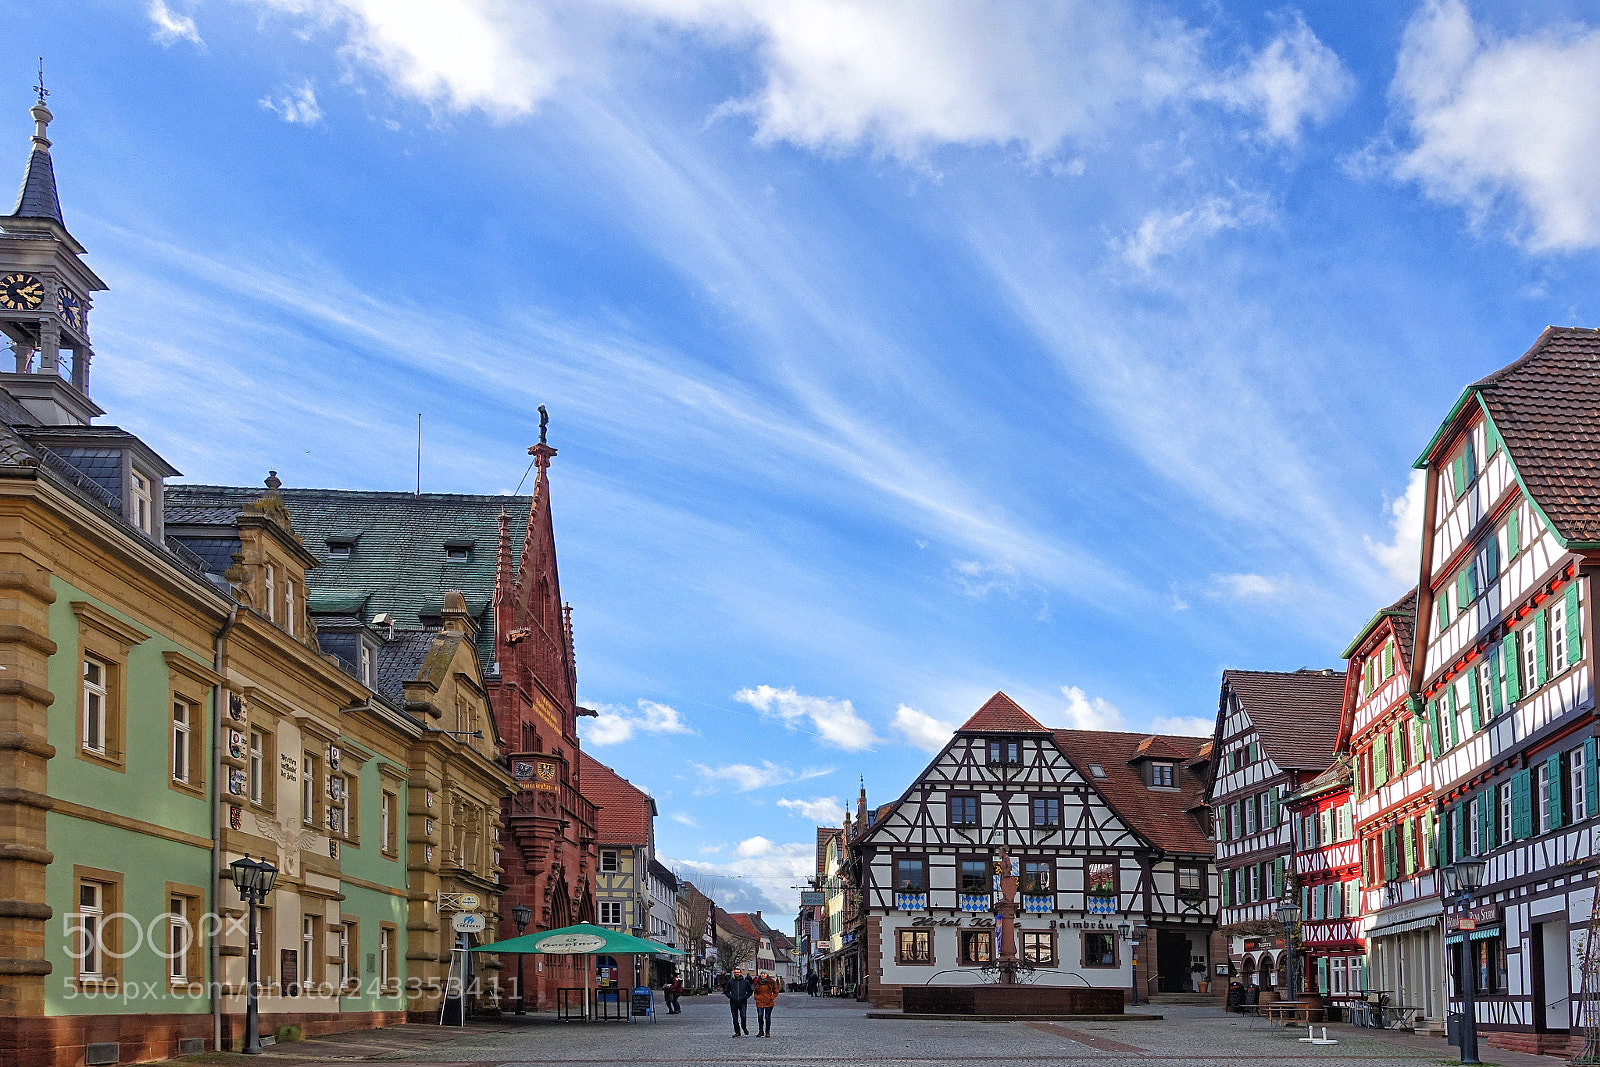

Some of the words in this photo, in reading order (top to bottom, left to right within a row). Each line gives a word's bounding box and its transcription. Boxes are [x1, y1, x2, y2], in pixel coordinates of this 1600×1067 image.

[912, 917, 961, 926] Hotel
[969, 917, 1021, 927] Kre
[1049, 919, 1113, 929] Palmbräu
